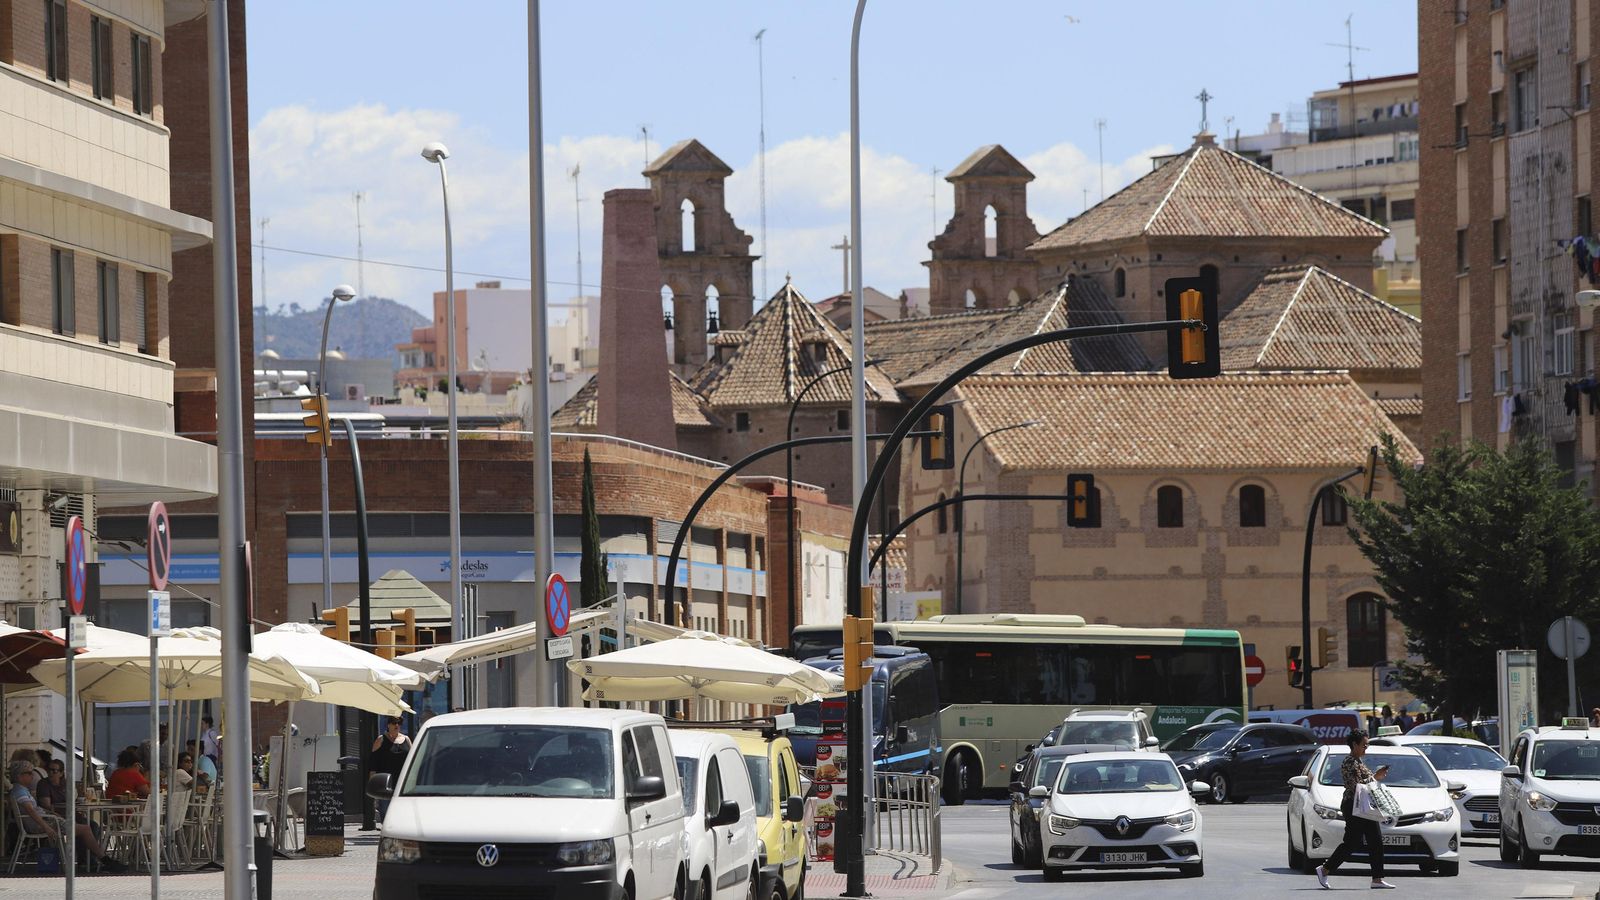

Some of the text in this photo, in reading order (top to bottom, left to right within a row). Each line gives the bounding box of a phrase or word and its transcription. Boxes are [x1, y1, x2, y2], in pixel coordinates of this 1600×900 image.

[461, 560, 488, 570] deslas
[1105, 853, 1145, 861] 3130 JHK
